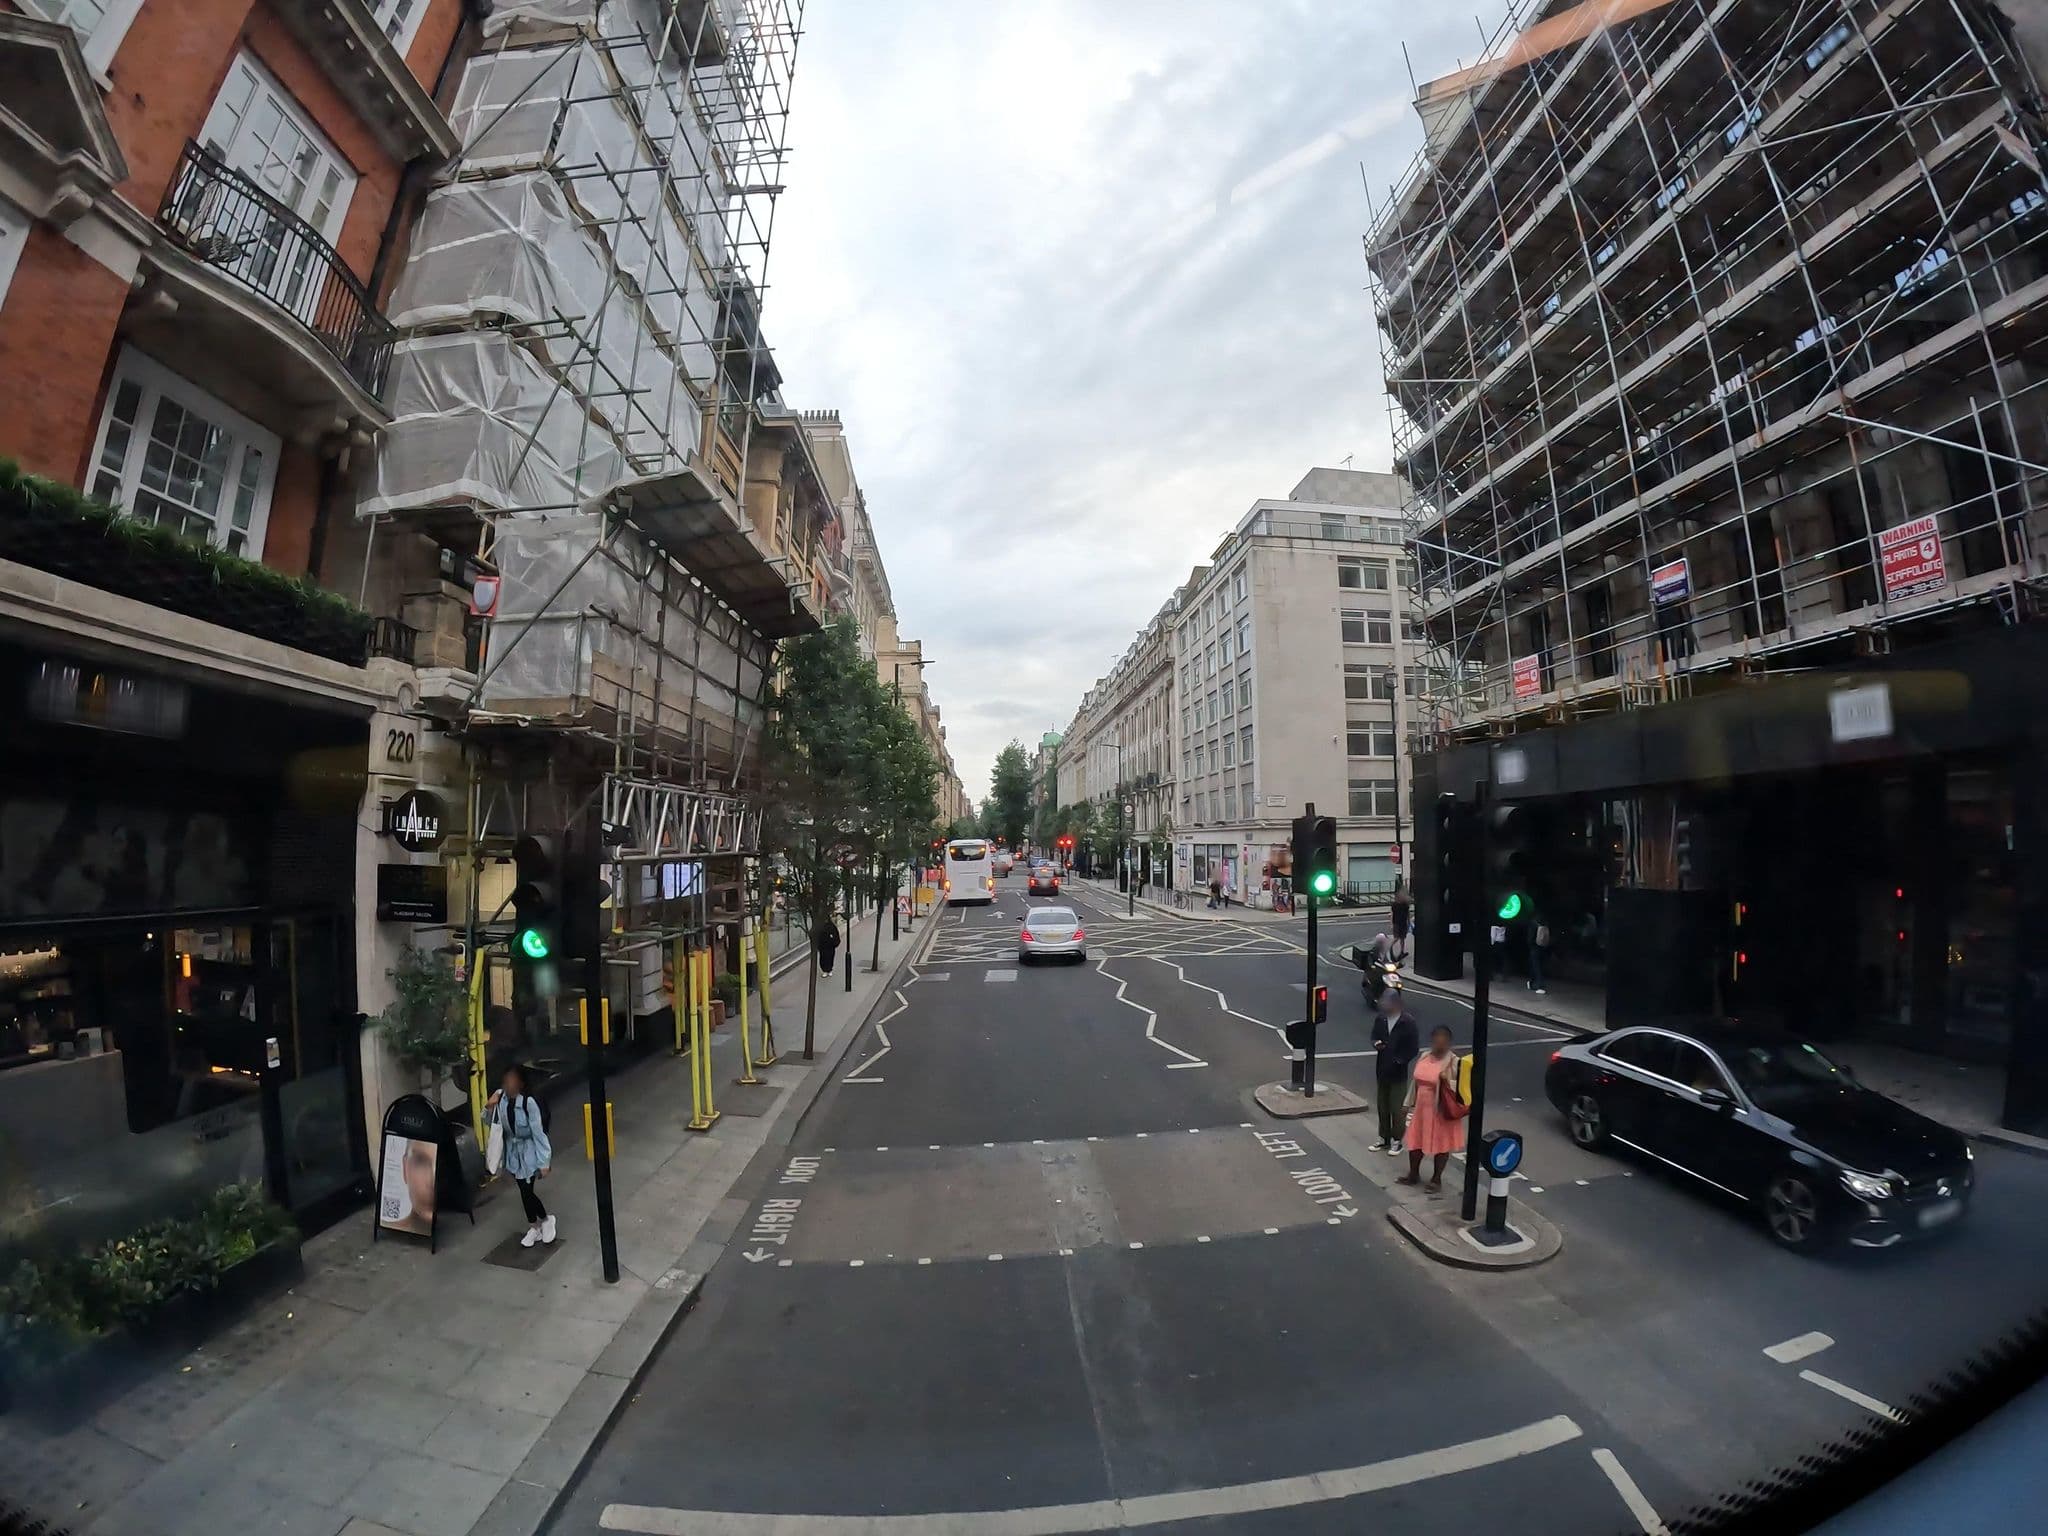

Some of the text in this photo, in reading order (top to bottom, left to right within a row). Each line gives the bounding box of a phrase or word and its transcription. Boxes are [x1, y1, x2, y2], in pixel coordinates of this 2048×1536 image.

[1882, 518, 1934, 545] WARNING
[1884, 542, 1933, 564] ALARMS 4
[1886, 559, 1942, 583] SCAFFOLDING
[387, 729, 415, 762] 220
[1253, 1132, 1352, 1204] LOOK LEFT
[749, 1156, 821, 1245] LOOK RIGHT
